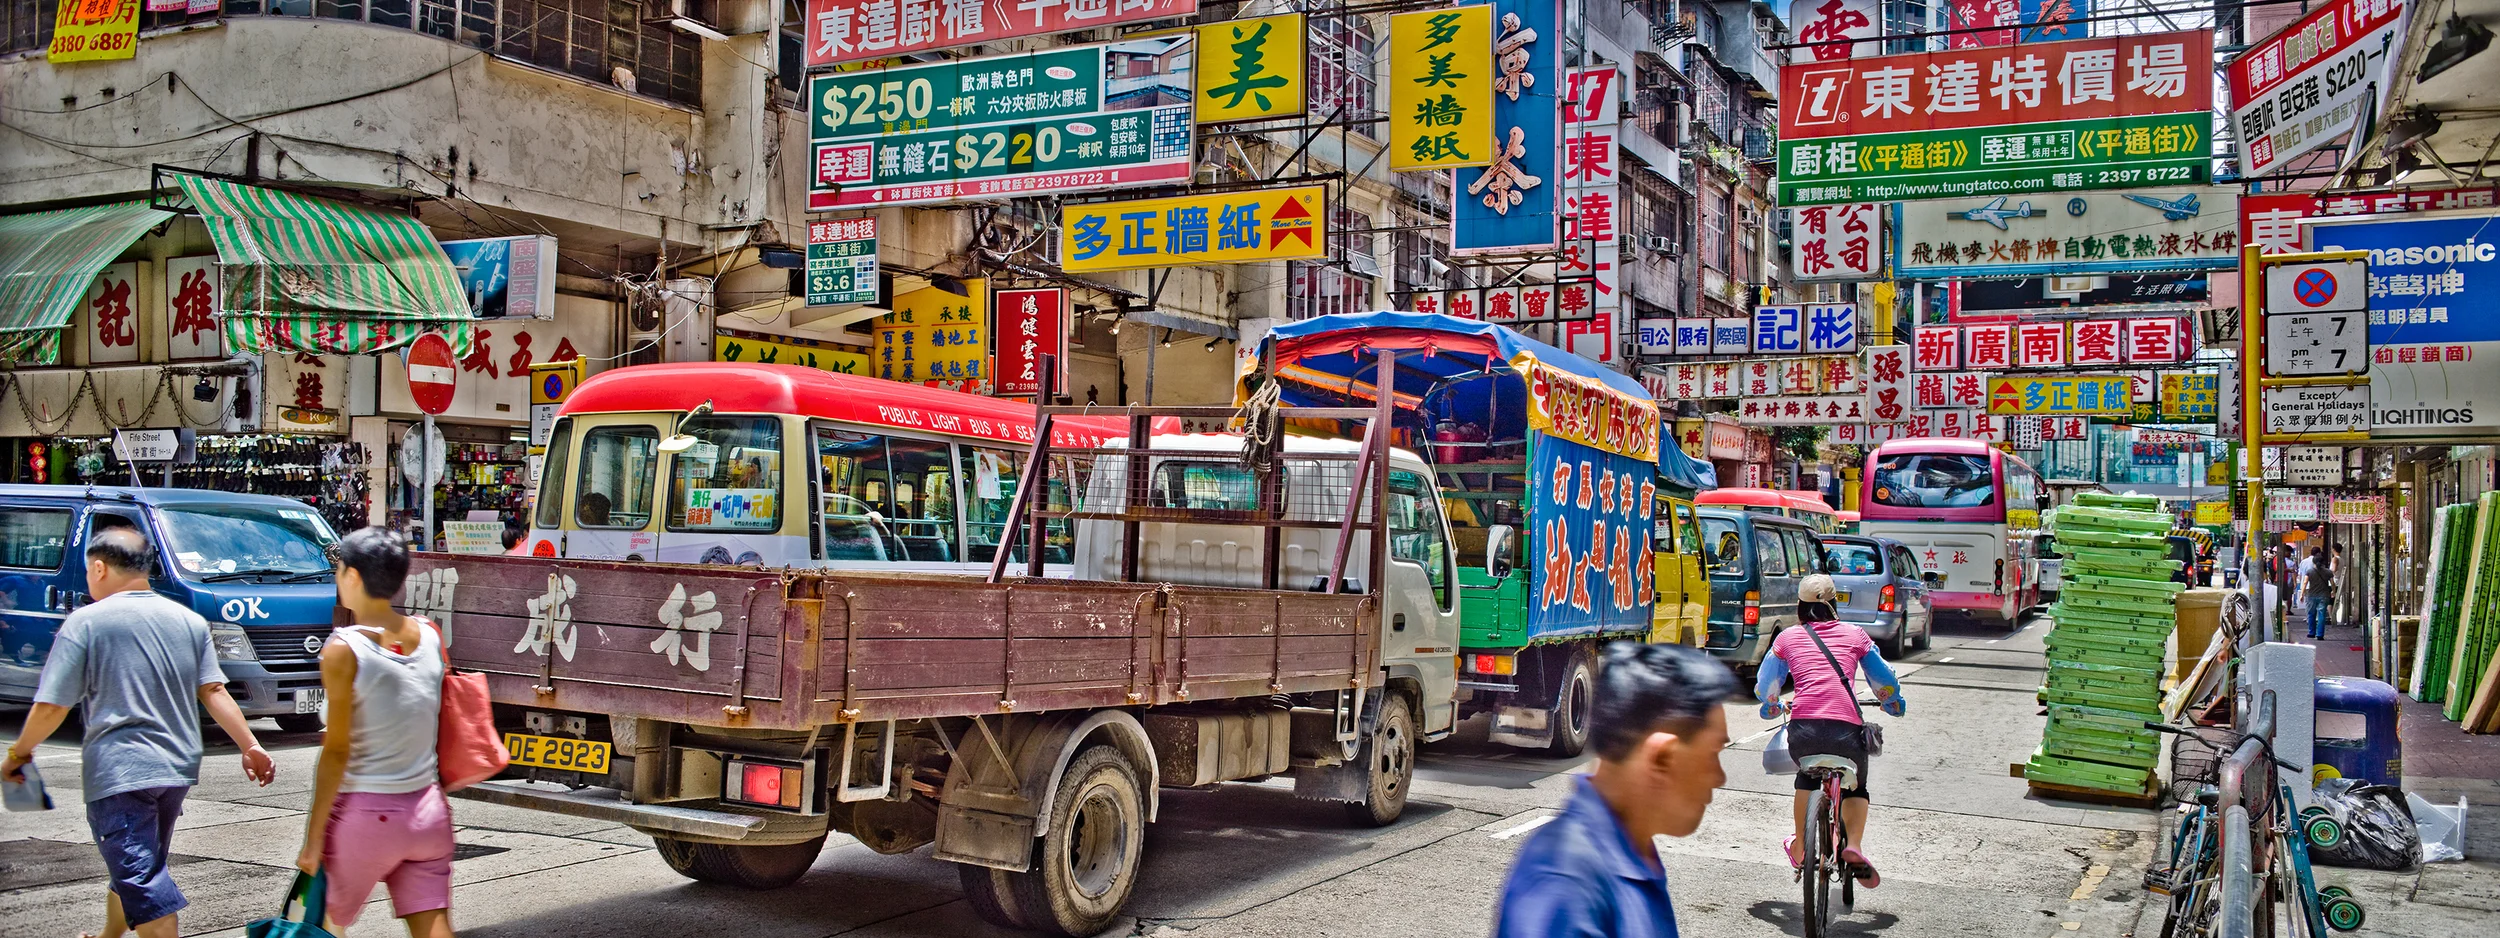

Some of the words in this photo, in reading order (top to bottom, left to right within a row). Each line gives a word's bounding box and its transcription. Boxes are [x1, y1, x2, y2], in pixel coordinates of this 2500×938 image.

[89, 32, 133, 51] 6887
[815, 0, 985, 58] 東達廚櫃
[1799, 0, 1870, 61] 雷
[2250, 50, 2282, 91] 幸運
[2284, 16, 2338, 73] 無縫石
[1206, 22, 1290, 112] 美
[1409, 12, 1471, 163] 多美牆紙
[1860, 42, 2189, 119] 東達特價場
[821, 77, 933, 132] $250
[2241, 98, 2277, 144] 包度呎
[2278, 74, 2320, 123] 包安裝
[821, 150, 869, 181] 幸運
[878, 140, 951, 178] 無縫石
[953, 127, 1062, 174] $220
[2032, 147, 2070, 159] 保用十年
[2077, 123, 2200, 159] 《平通街》
[2252, 138, 2272, 165] 幸運
[1858, 139, 1969, 173] 《平通街》
[1984, 136, 2027, 162] 幸運
[1036, 172, 1104, 189] 23978722
[1866, 175, 2045, 198] http://www.tungtatco.com
[2098, 168, 2142, 184] 2397
[2146, 166, 2191, 182] 8722
[1072, 202, 1261, 262] 多正牆紙
[1271, 219, 1292, 228] More
[1294, 218, 1313, 227] Keen
[1560, 245, 1590, 272] 文
[812, 274, 851, 293] $3.6
[92, 277, 136, 349] 記
[171, 268, 217, 346] 雄
[939, 306, 972, 323] 承接
[2287, 328, 2314, 338] 上午
[2331, 316, 2348, 337] 7
[1914, 319, 2179, 367] 新廣南餐室
[2287, 359, 2314, 370] 下午
[2291, 349, 2309, 359] pm
[2331, 349, 2348, 369] 7
[1872, 350, 1905, 421] 源昌
[2024, 380, 2127, 411] 多正牆紙
[2299, 391, 2337, 402] Except
[2272, 402, 2315, 412] General
[2317, 401, 2366, 413] Holidays
[2273, 412, 2365, 427] 公眾假期例外
[2371, 408, 2474, 425] LIGHTINGS
[878, 405, 922, 426] PUBLIC
[927, 413, 962, 432] LIGHT
[969, 419, 992, 436] BUS
[997, 422, 1010, 438] 16
[1015, 425, 1036, 441] SEA
[129, 433, 142, 442] Fife
[142, 432, 161, 442] Street
[132, 447, 157, 458] 快富街
[721, 494, 743, 518] 屯門
[751, 494, 773, 518] 元朗
[537, 543, 550, 552] PSL
[1952, 550, 1969, 565] 旅
[221, 596, 270, 622] OK
[508, 737, 536, 763] DE
[543, 741, 607, 770] 2923
